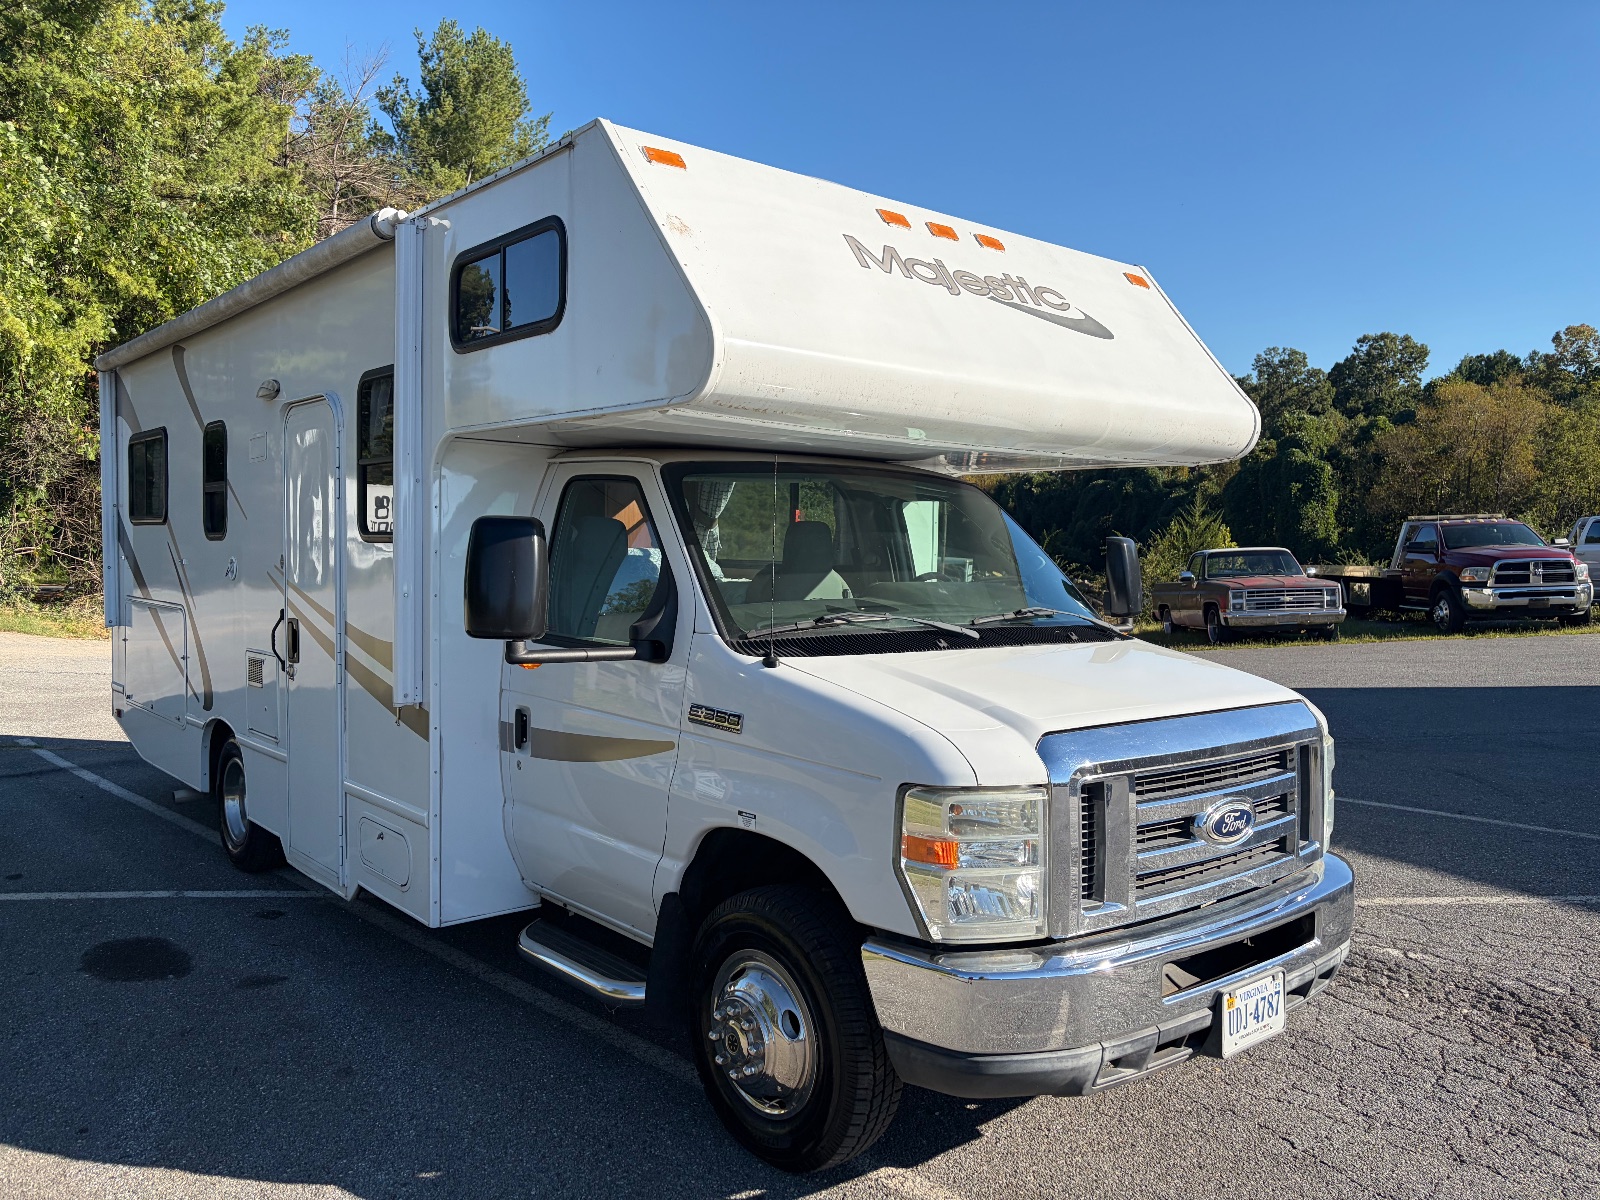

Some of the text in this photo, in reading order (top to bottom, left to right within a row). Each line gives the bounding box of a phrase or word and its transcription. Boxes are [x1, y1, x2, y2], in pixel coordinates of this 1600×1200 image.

[842, 233, 1070, 311] Majestic
[1221, 811, 1247, 834] Ford
[1239, 983, 1268, 1003] VIRGINIA
[1228, 990, 1280, 1037] UDJ-4787
